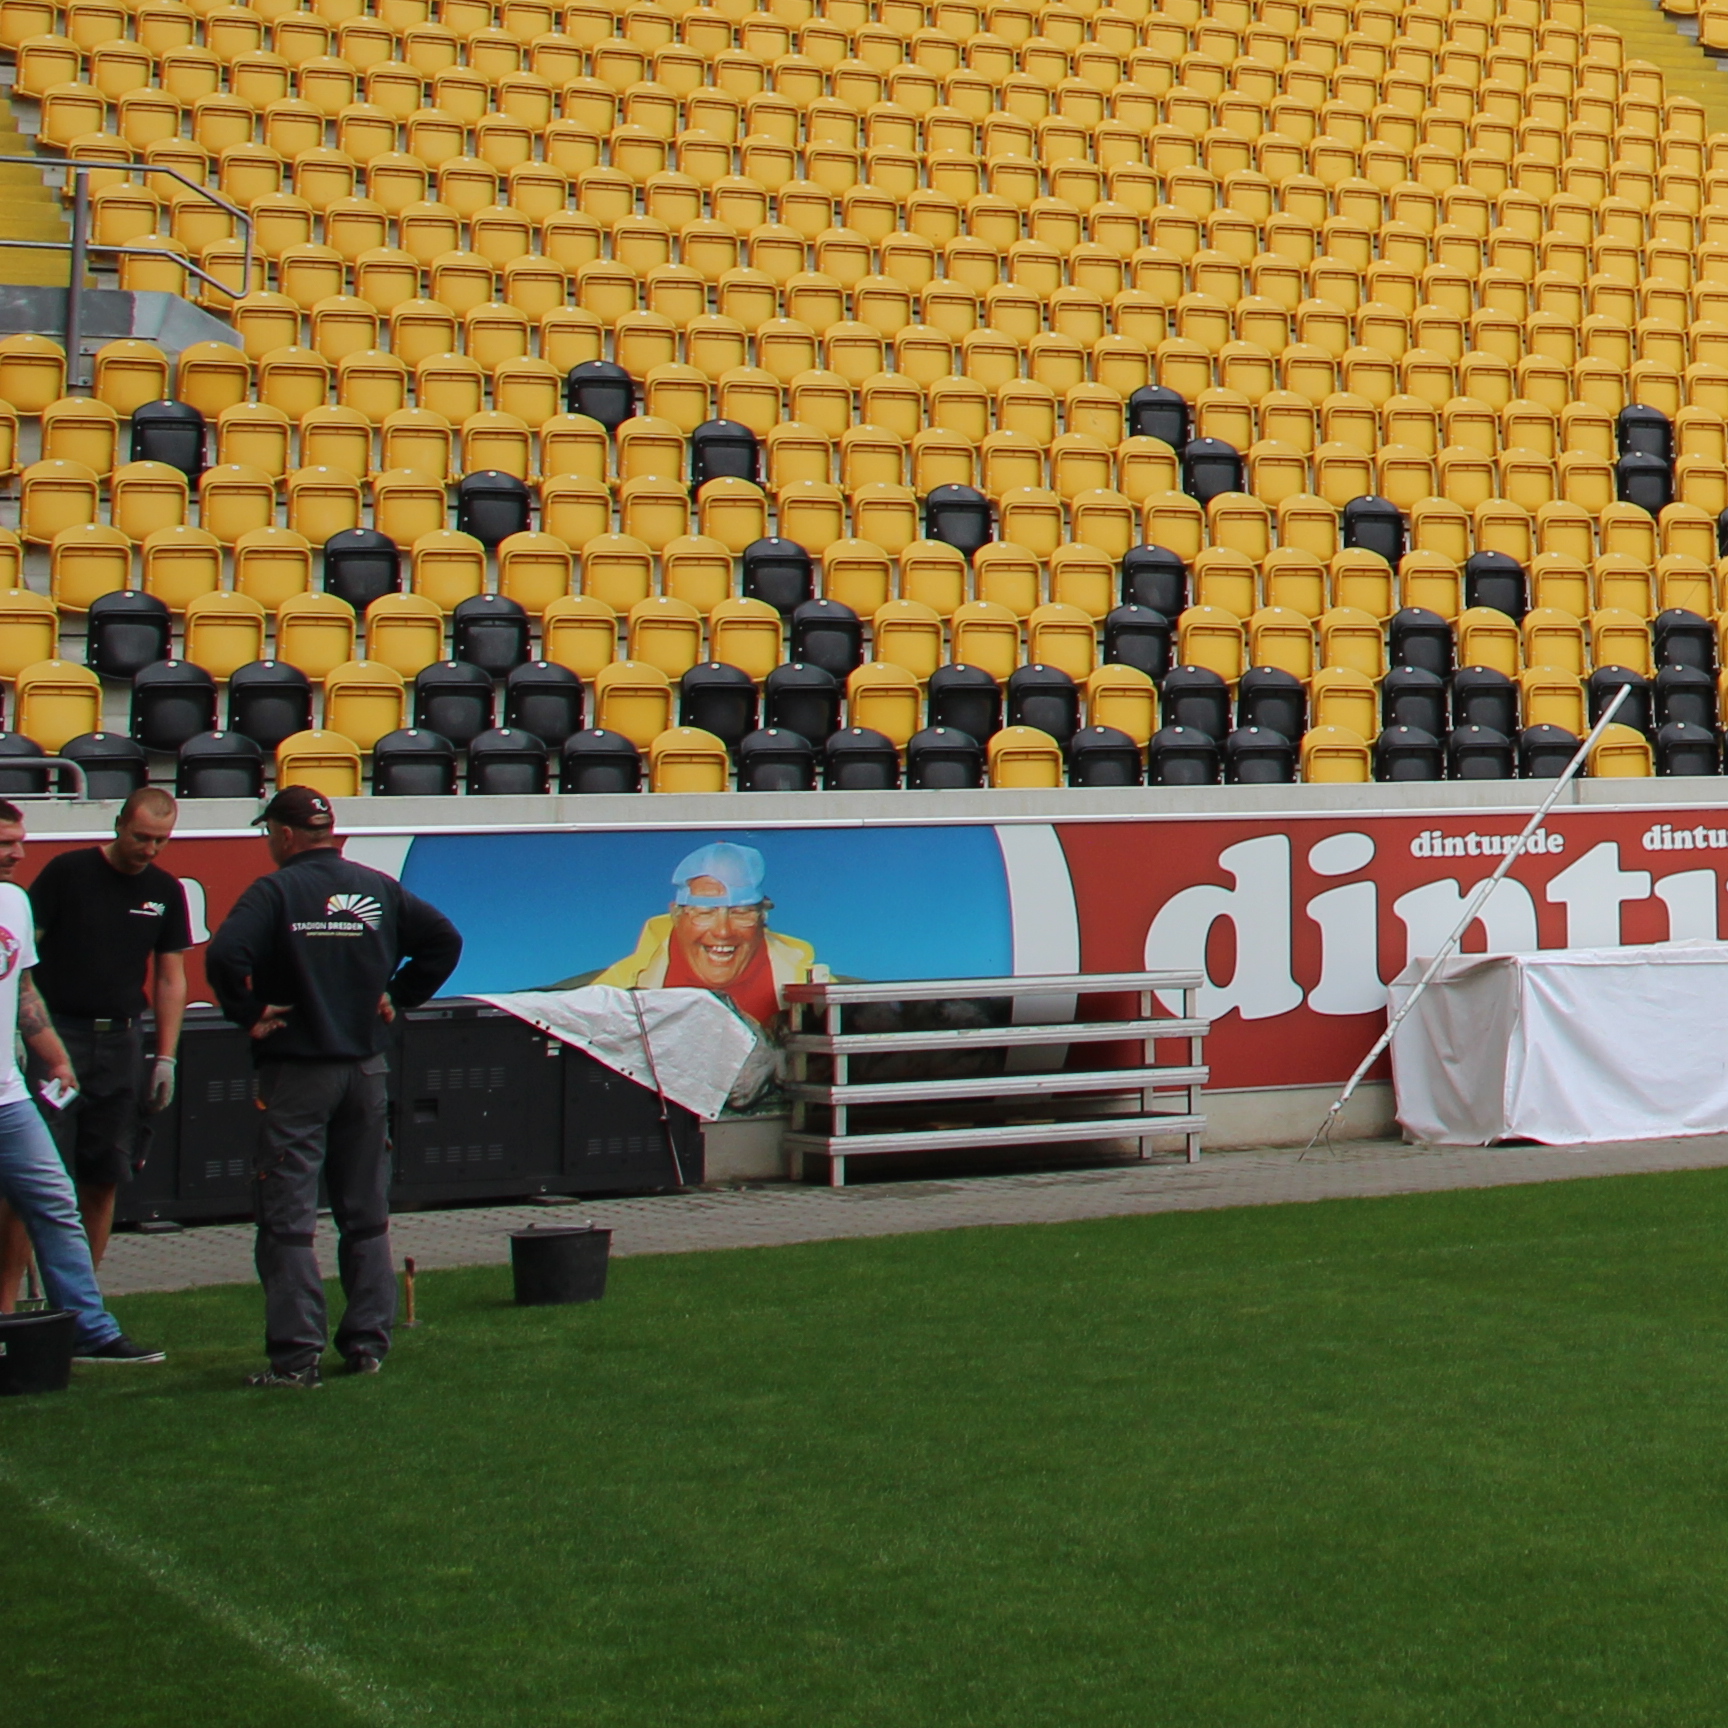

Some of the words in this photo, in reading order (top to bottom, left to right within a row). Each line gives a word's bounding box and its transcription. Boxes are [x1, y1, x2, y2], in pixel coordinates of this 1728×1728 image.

[1410, 828, 1565, 859] dintur.de
[291, 922, 326, 932] STADION
[328, 922, 364, 931] DRESDEN
